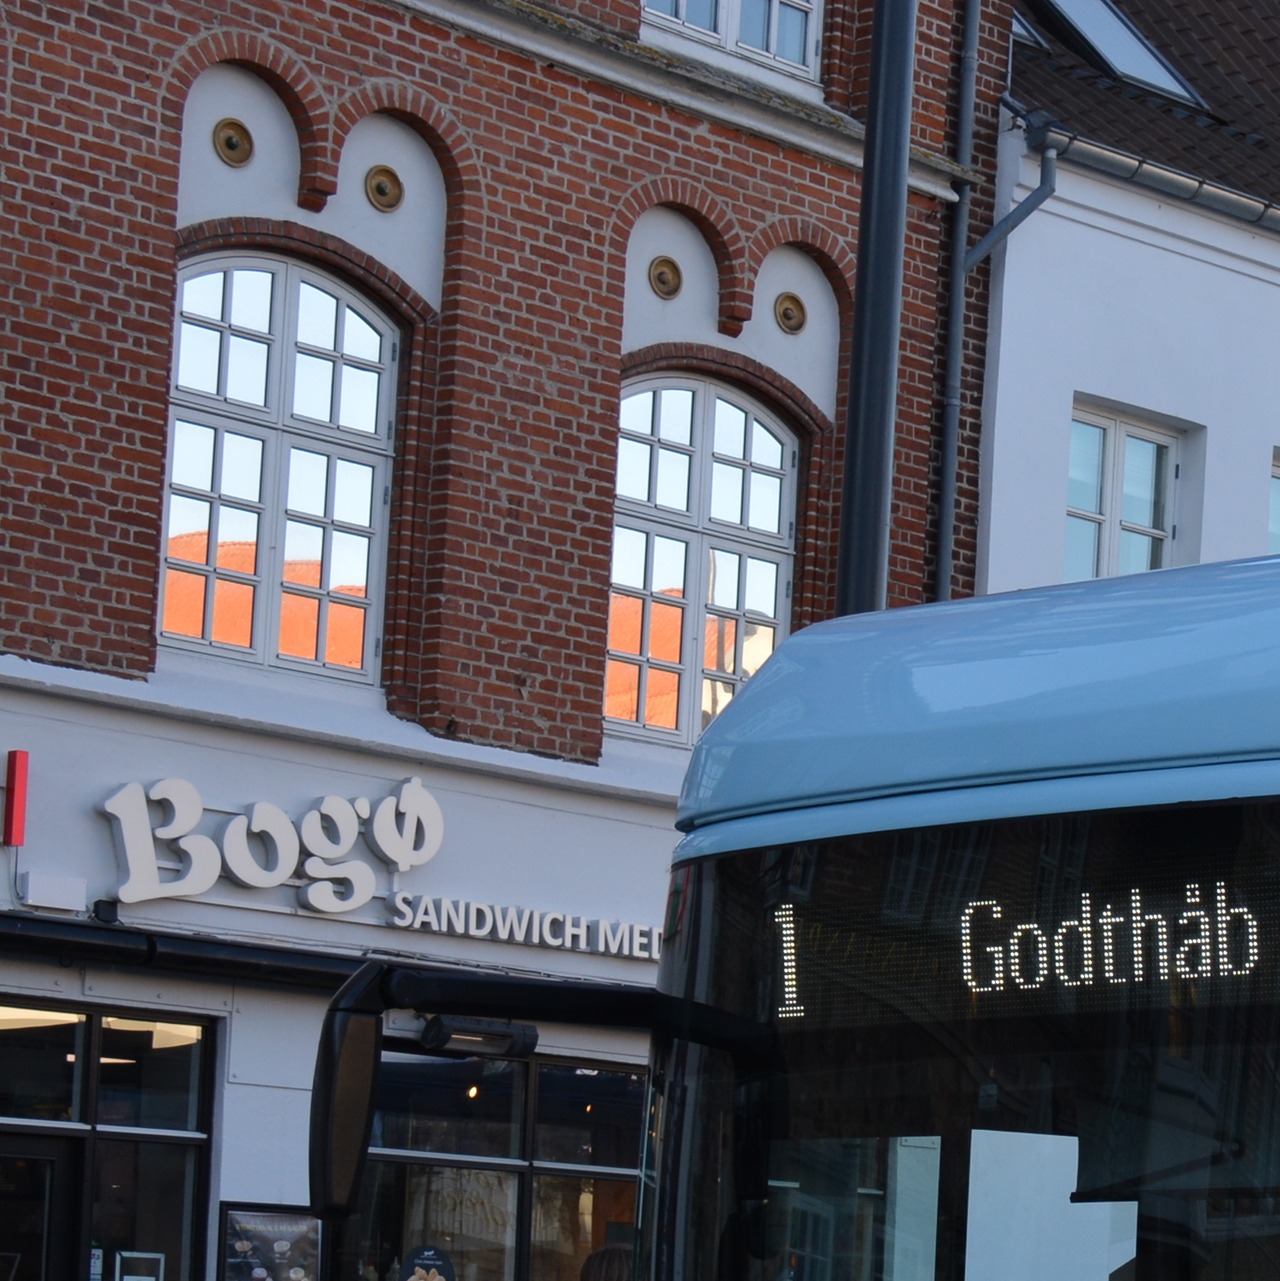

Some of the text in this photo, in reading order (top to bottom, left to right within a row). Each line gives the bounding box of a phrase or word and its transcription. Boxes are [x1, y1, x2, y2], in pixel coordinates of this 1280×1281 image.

[103, 776, 445, 914] Bogø
[391, 890, 588, 951] SANDWICH
[773, 881, 1260, 1018] 1 Godthåb
